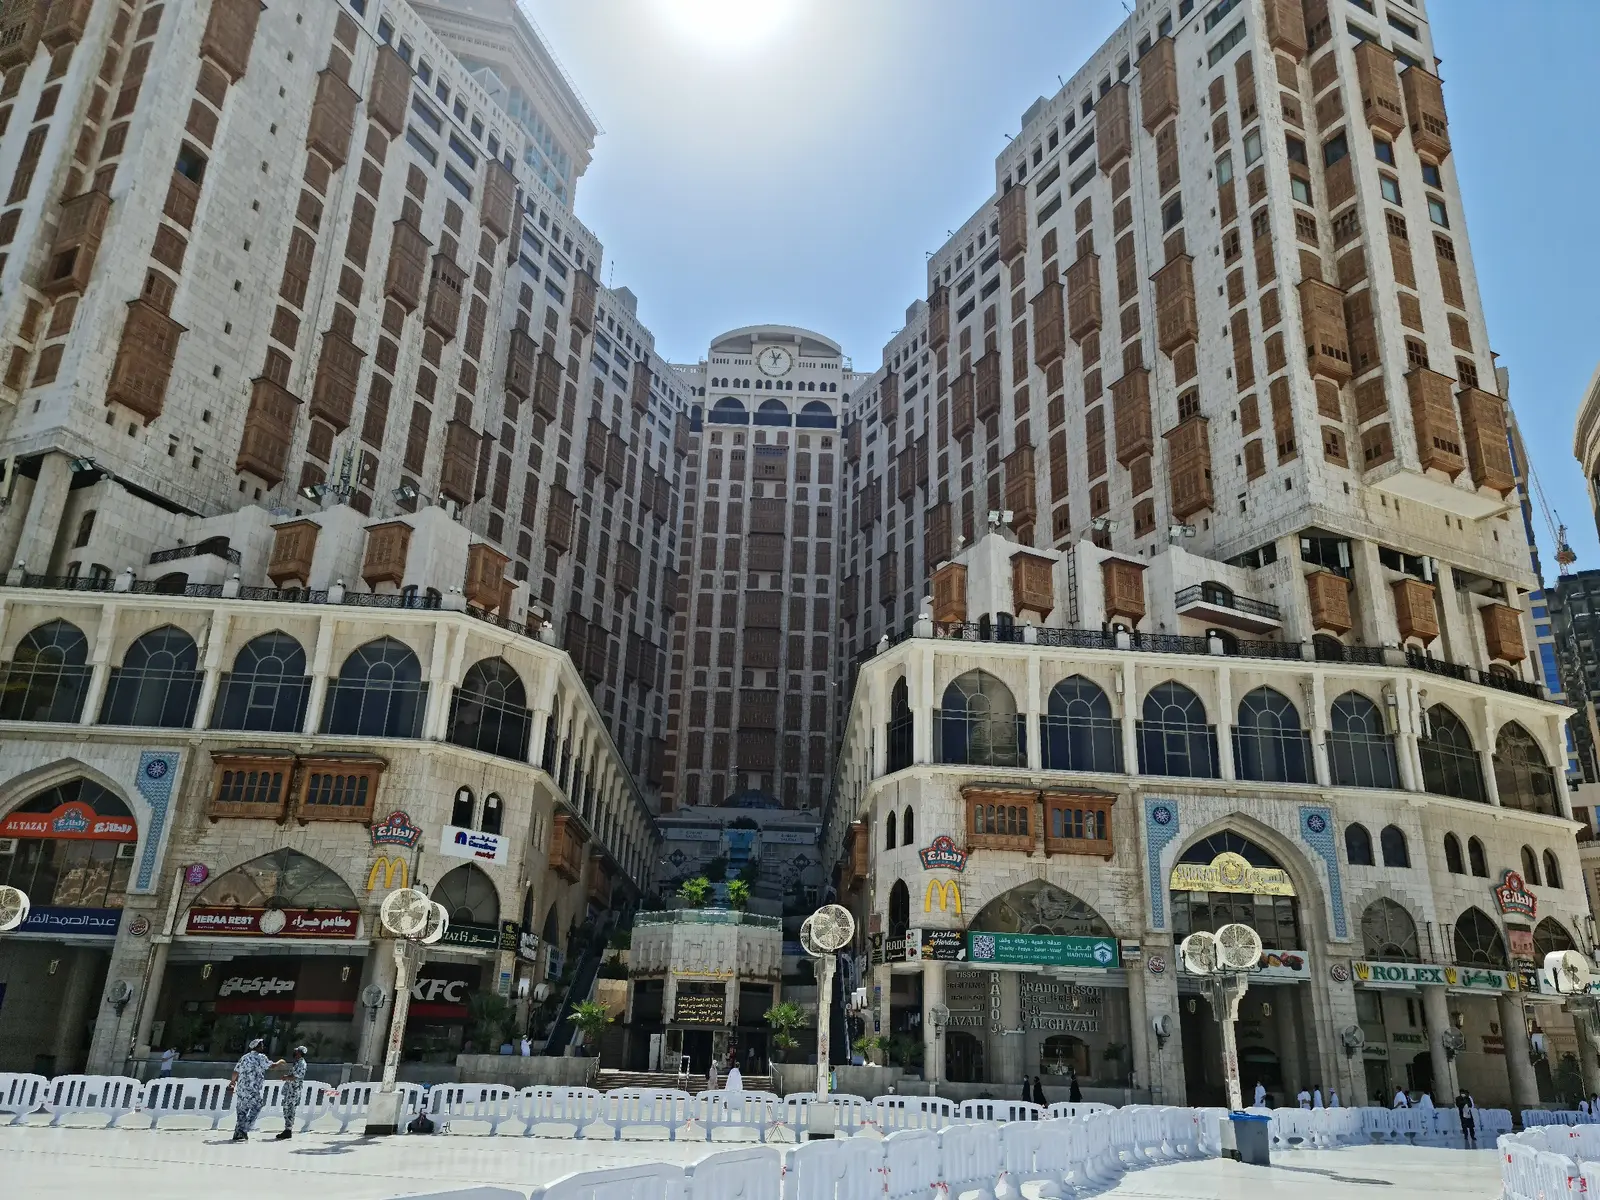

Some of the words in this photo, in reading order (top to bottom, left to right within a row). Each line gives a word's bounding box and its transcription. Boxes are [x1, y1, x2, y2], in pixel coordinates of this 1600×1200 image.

[6, 822, 18, 830] AL
[20, 822, 47, 831] TAZAJ
[377, 825, 415, 839] الطازج
[927, 850, 962, 862] الطازج
[1502, 890, 1532, 906] الطازج
[192, 914, 226, 924] HERAA
[227, 916, 253, 924] REST
[1371, 964, 1444, 982] ROLEX
[410, 978, 463, 1002] KFC
[989, 971, 999, 1020] RADO
[1026, 982, 1059, 993] RADO
[1063, 984, 1100, 995] TISSOT
